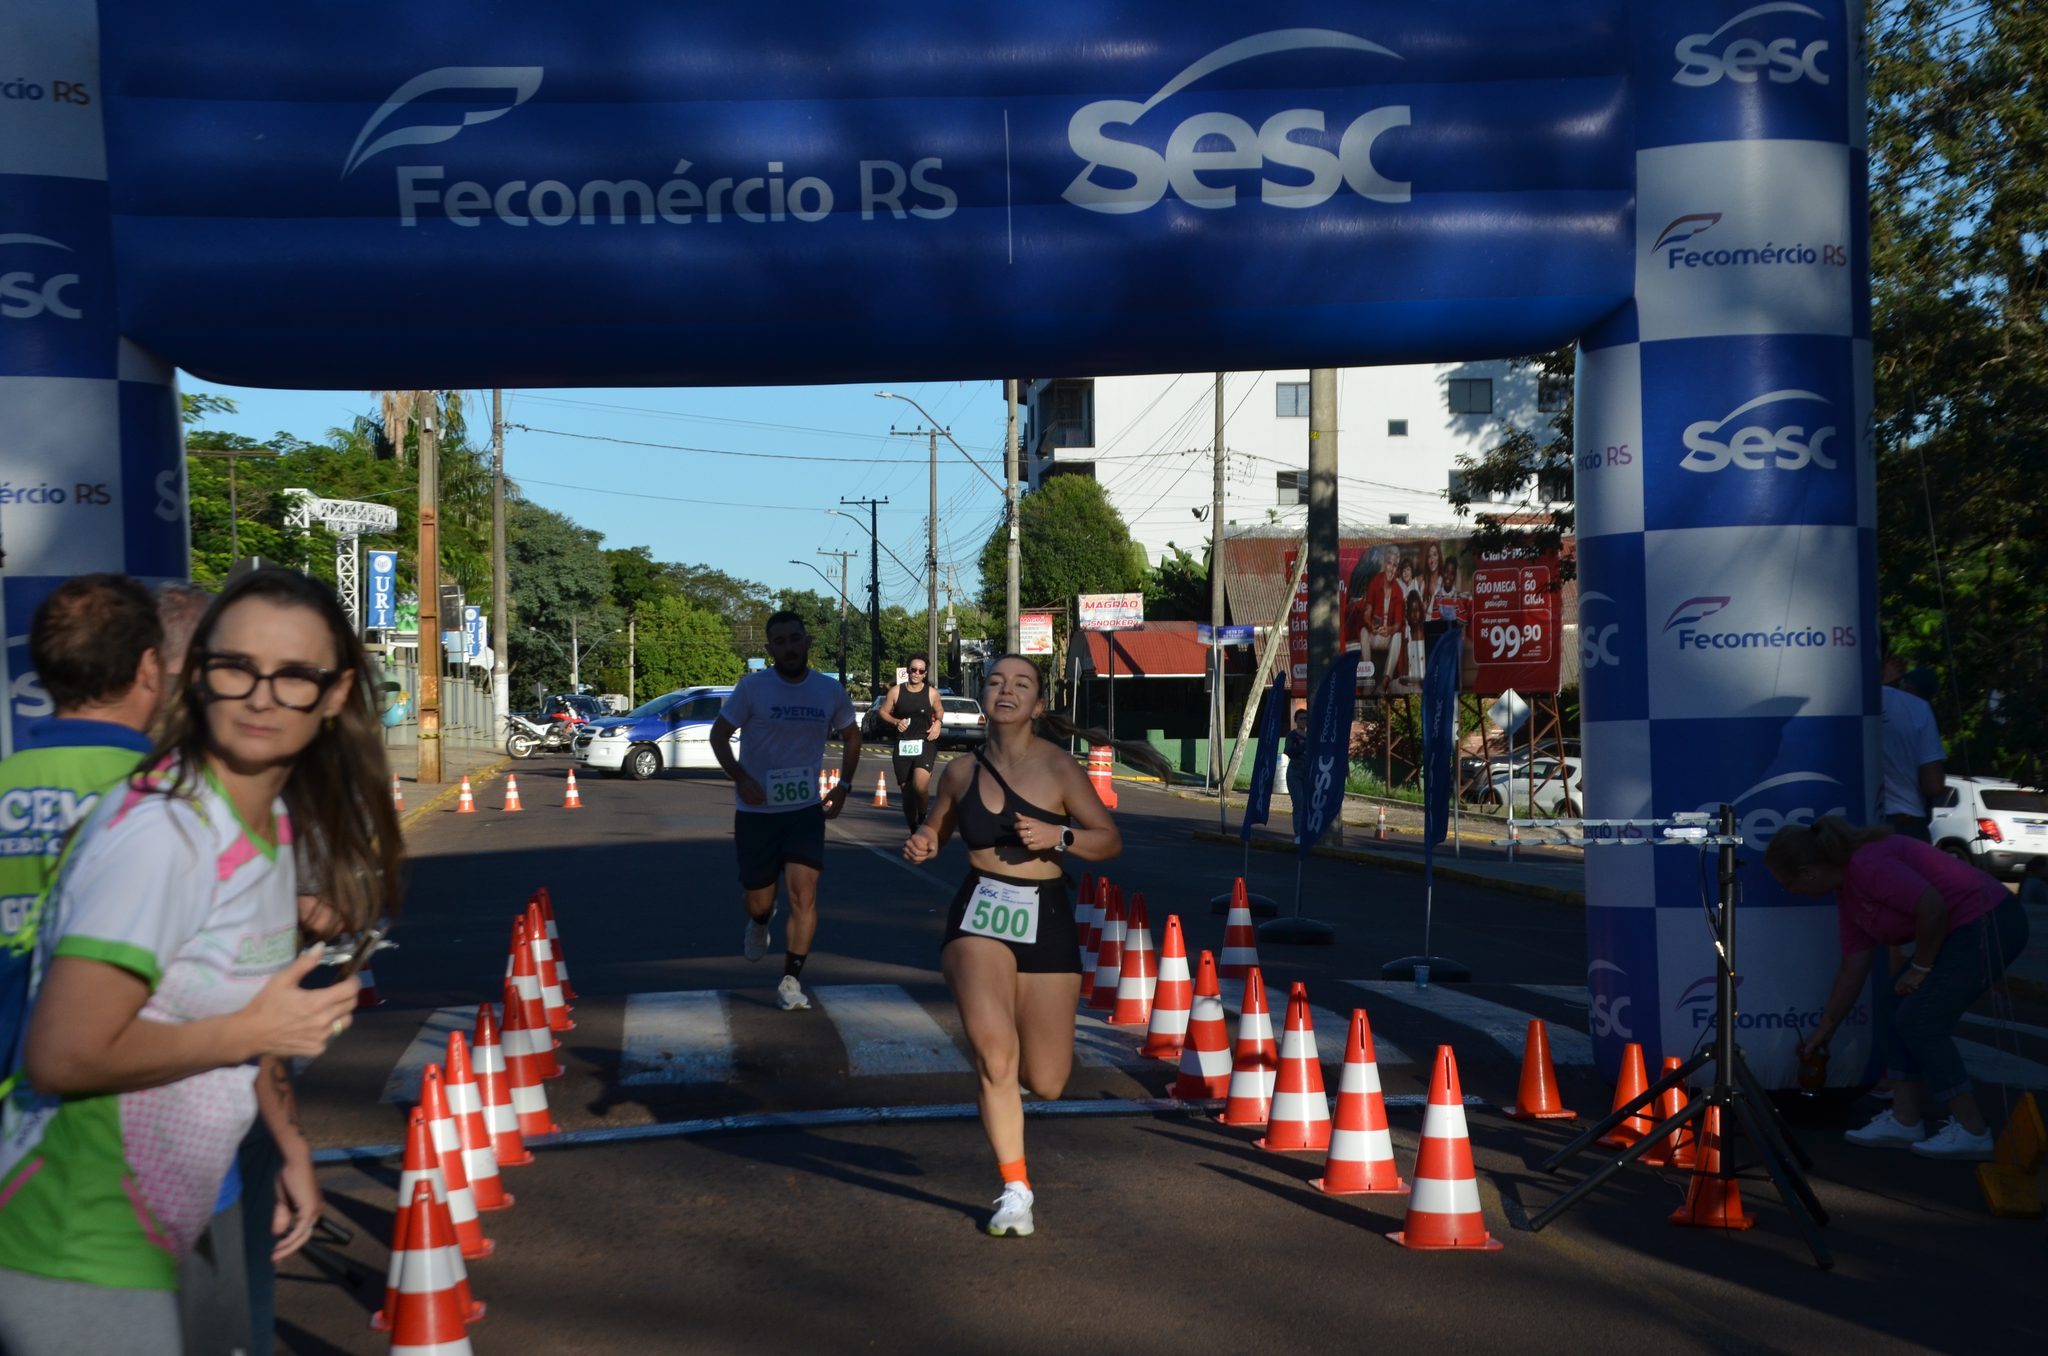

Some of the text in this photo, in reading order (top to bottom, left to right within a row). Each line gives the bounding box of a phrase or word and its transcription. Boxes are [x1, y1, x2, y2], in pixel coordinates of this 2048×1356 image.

[1672, 33, 1830, 87] Sesc
[0, 77, 92, 106] cio RS
[1061, 99, 1411, 215] Sesc
[395, 157, 958, 227] Fecomércio RS
[1668, 242, 1847, 269] Fecomércio RS
[1606, 444, 1632, 466] RS
[1679, 420, 1838, 473] Sesc
[75, 483, 112, 505] RS
[1476, 581, 1517, 594] 600 MEGA
[1524, 579, 1537, 591] 60
[375, 576, 391, 626] URI
[1678, 626, 1857, 650] Fecomércio RS
[782, 705, 826, 718] VETRIA
[902, 743, 920, 754] 426
[773, 781, 810, 802] 366
[972, 900, 1029, 938] 500
